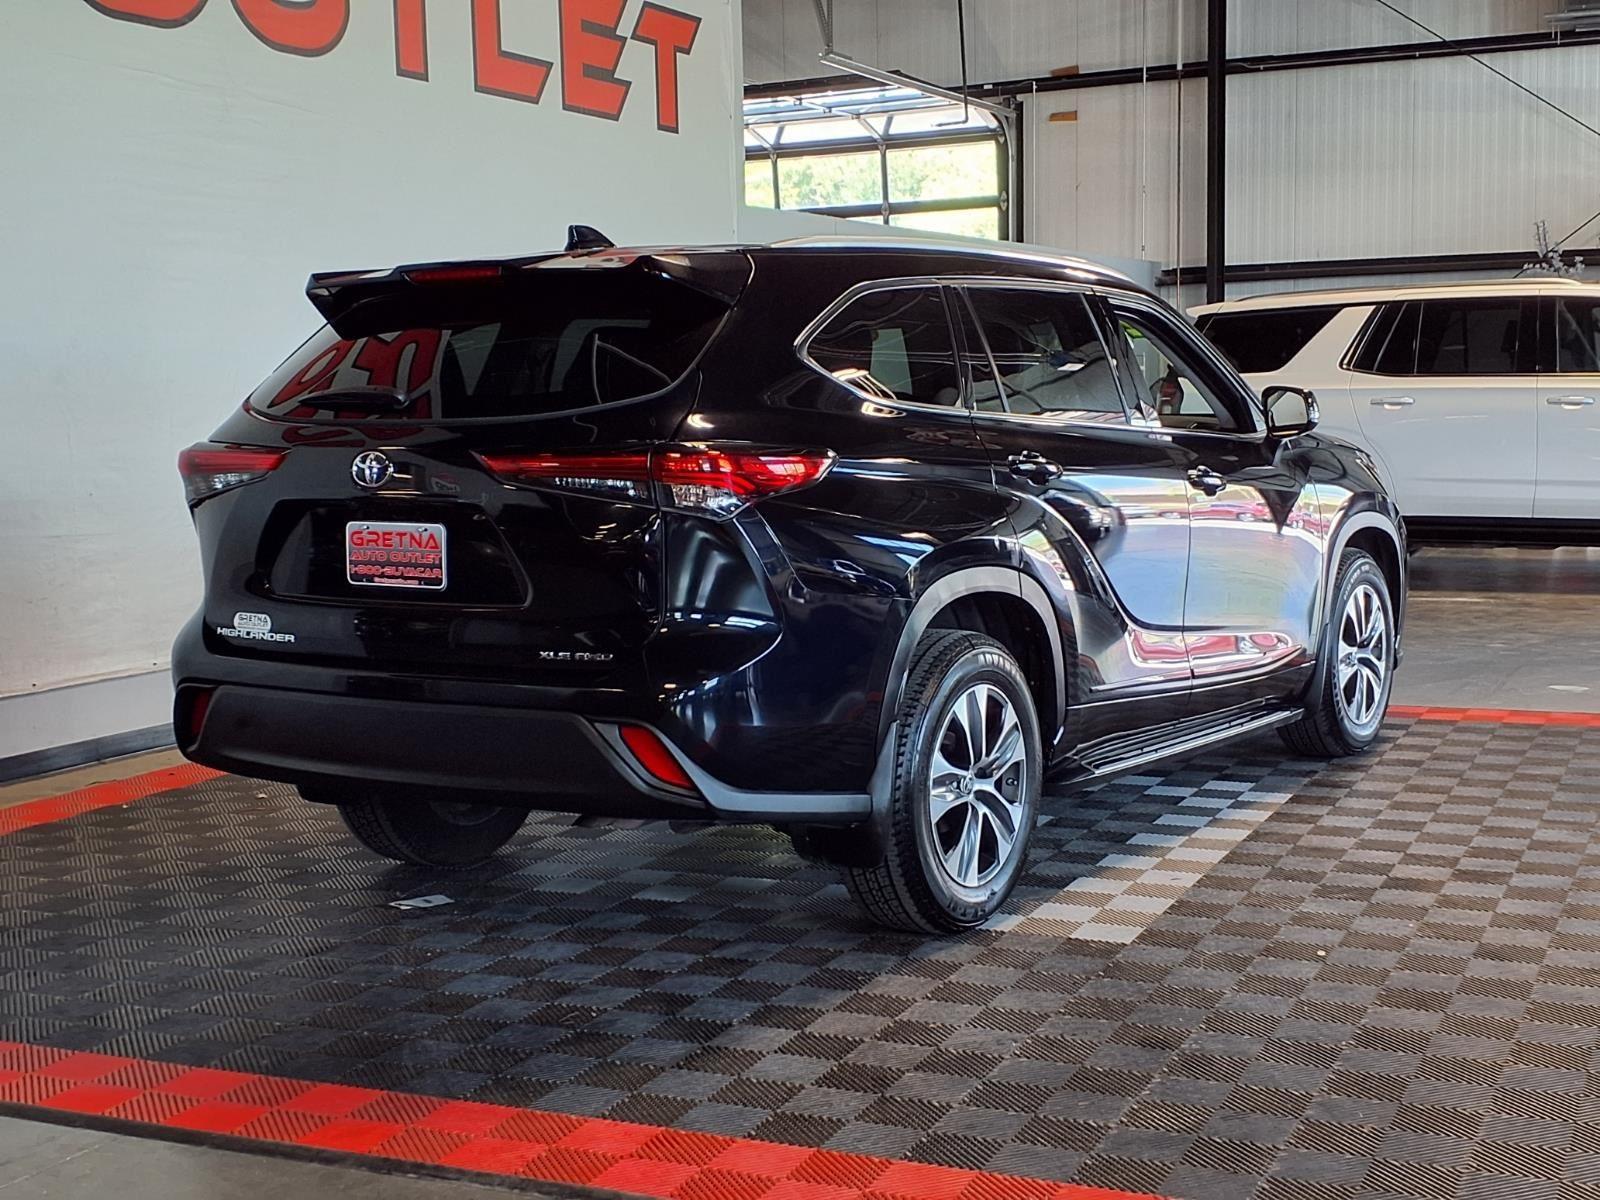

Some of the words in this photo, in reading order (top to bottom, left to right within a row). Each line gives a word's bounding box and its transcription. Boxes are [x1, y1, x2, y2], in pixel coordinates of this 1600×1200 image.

[350, 530, 440, 549] GRETNA
[350, 550, 387, 562] AUTO
[390, 551, 441, 563] OUTLET
[238, 614, 268, 623] GRETNA
[217, 627, 295, 643] HIGHLANDER
[539, 651, 571, 660] XLE
